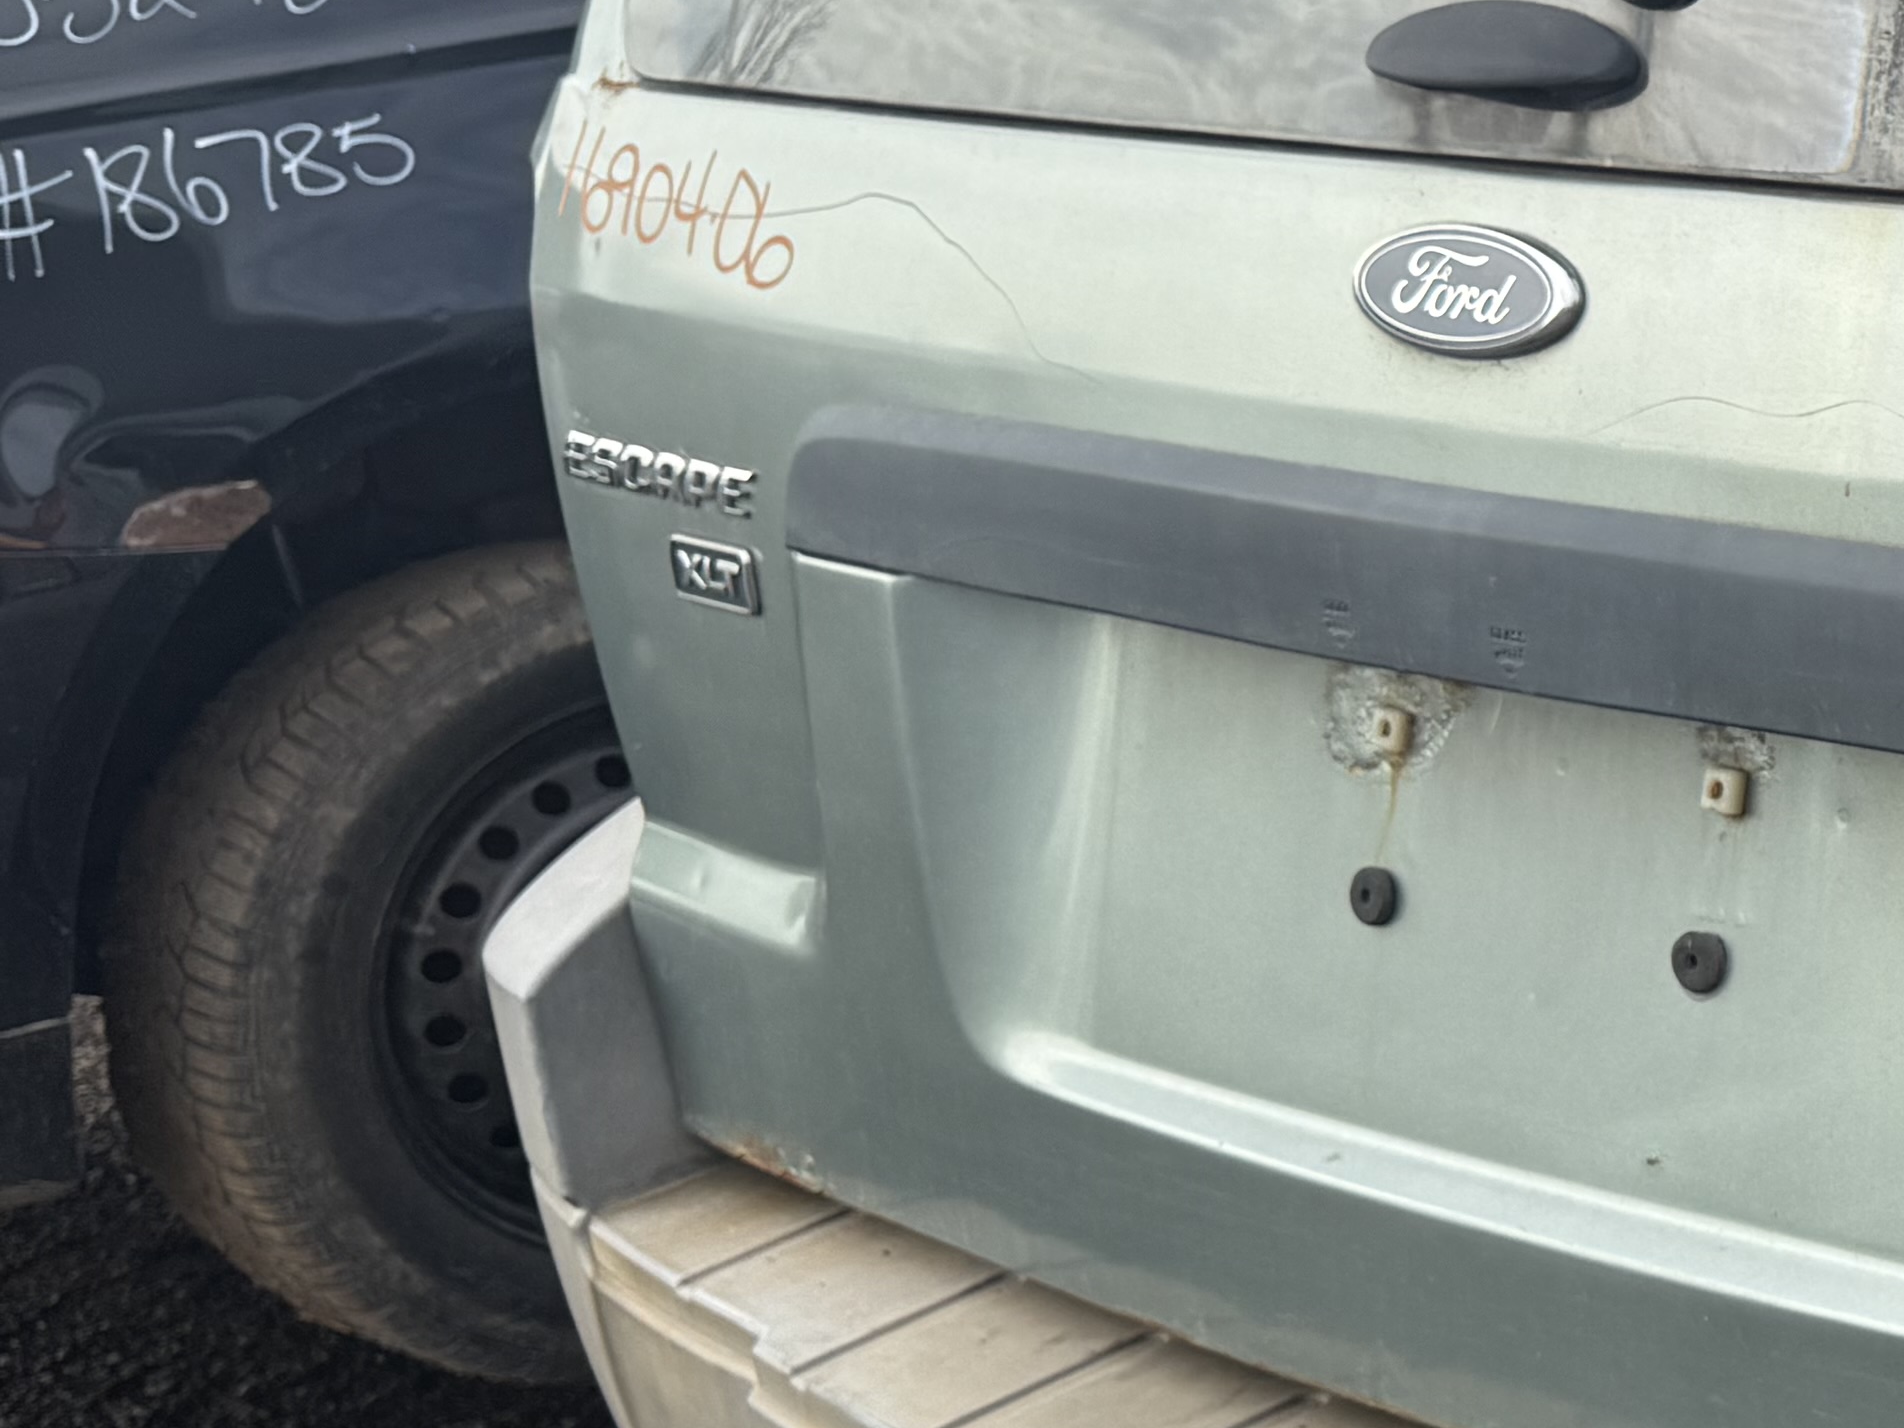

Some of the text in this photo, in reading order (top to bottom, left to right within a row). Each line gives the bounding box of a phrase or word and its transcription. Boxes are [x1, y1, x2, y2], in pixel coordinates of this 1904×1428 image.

[1391, 245, 1517, 325] Ford
[565, 429, 757, 519] ESCAPE
[674, 548, 742, 598] XLT
